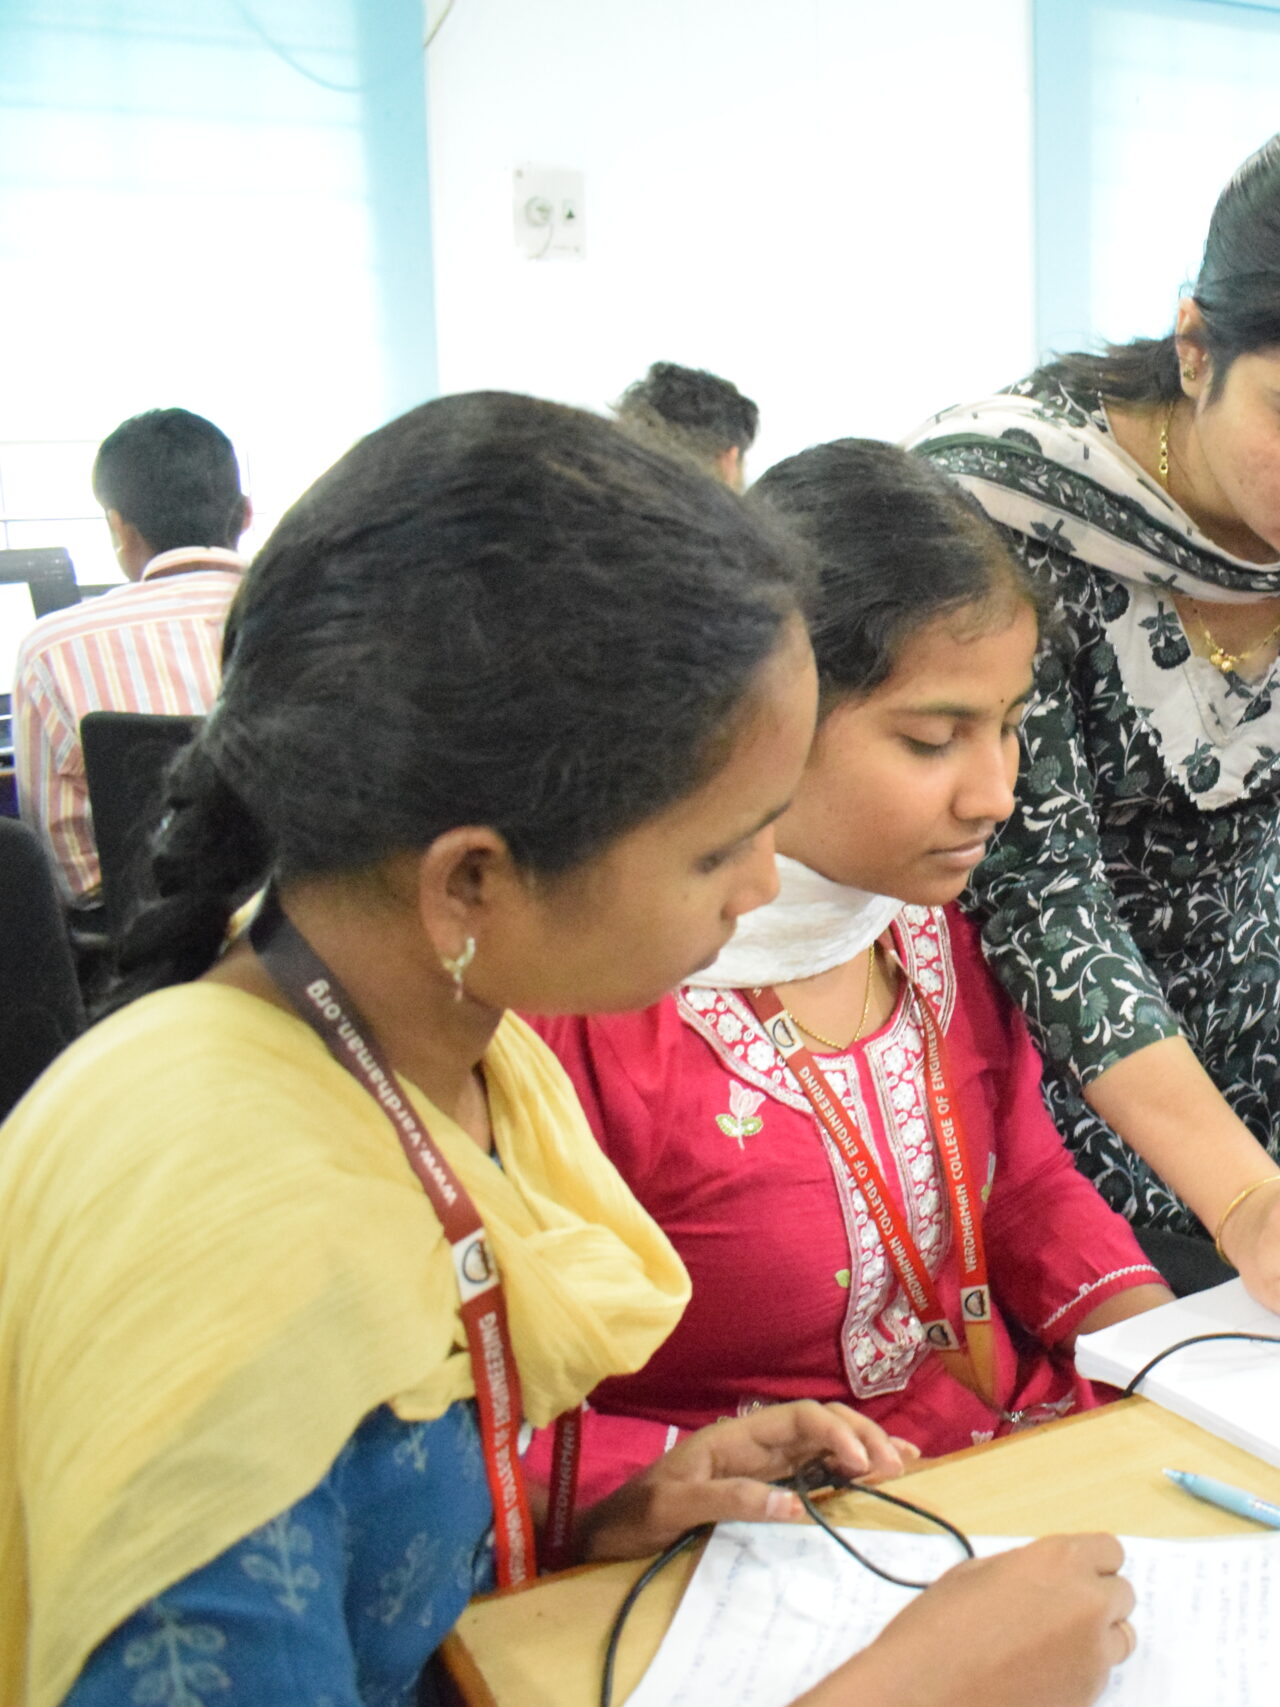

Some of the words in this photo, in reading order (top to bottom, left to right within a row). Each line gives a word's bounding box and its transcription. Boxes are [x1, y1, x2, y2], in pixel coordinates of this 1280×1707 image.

[307, 978, 457, 1206] www.vardhaman.org
[799, 1066, 859, 1159] ENGINEERING
[938, 1096, 951, 1118] OF
[852, 1159, 869, 1180] OF
[940, 1117, 964, 1180] COLLEGE
[858, 1175, 899, 1239] COLLEGE
[956, 1184, 977, 1274] VARDHAMAN
[889, 1237, 929, 1312] VARDHAMAN
[479, 1311, 511, 1427] ENGINEERING
